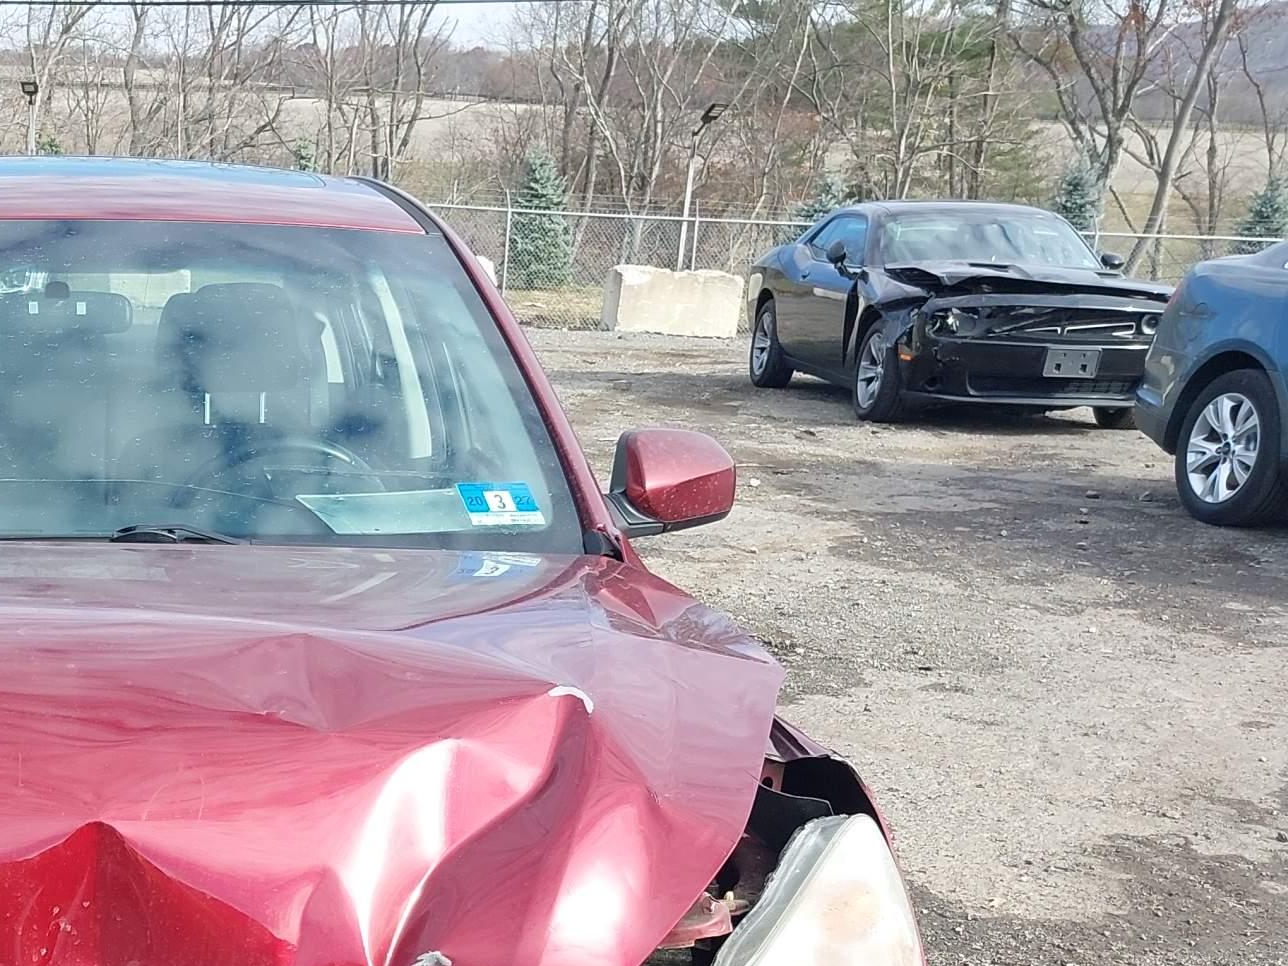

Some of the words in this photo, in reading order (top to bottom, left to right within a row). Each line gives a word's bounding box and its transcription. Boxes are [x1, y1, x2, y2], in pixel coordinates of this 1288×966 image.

[468, 496, 483, 506] 20
[494, 494, 507, 510] 3
[514, 495, 532, 506] 27
